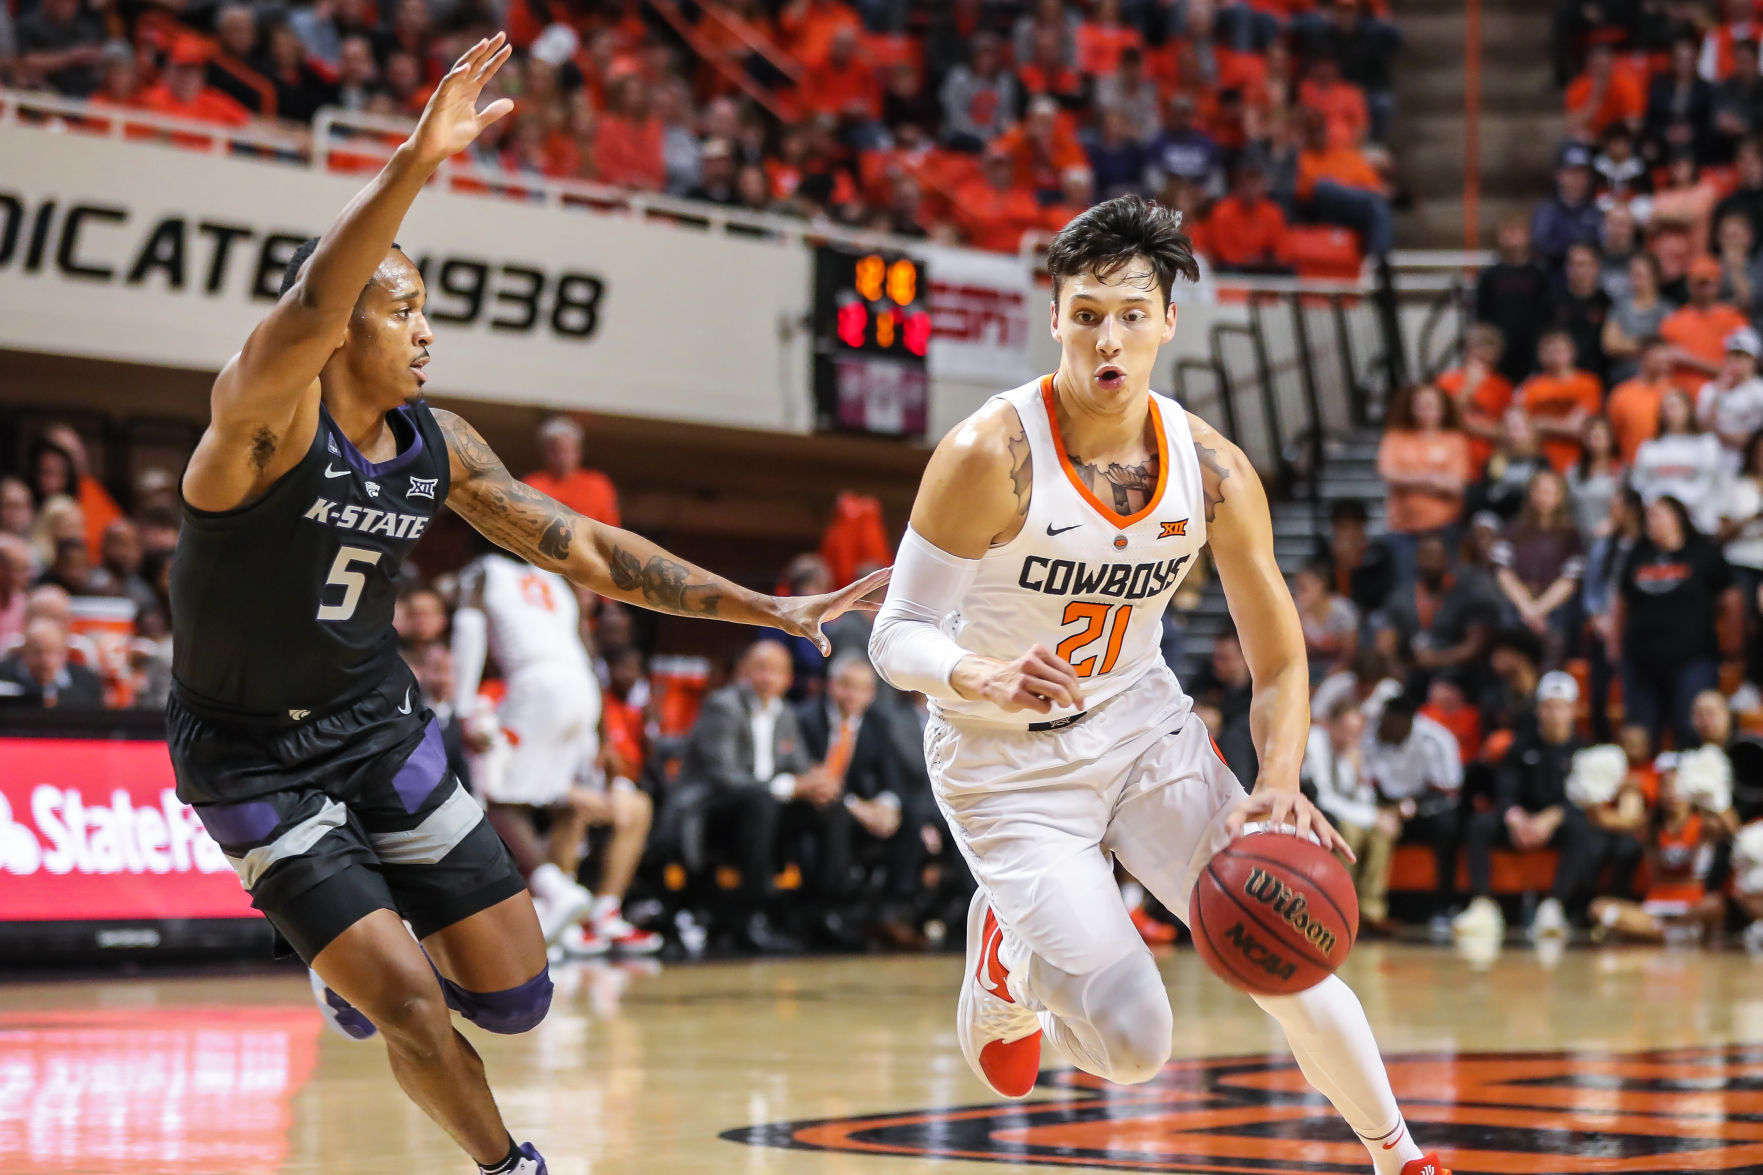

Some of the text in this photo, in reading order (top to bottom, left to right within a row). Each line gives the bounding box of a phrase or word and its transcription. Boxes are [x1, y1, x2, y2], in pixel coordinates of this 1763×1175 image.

[304, 498, 430, 539] K-STATE
[1157, 518, 1189, 539] XII
[316, 545, 383, 621] 5
[1018, 554, 1191, 600] COWBOYS
[1055, 600, 1133, 678] 21
[1244, 866, 1336, 957] Wilson
[1224, 921, 1298, 982] NCAA
